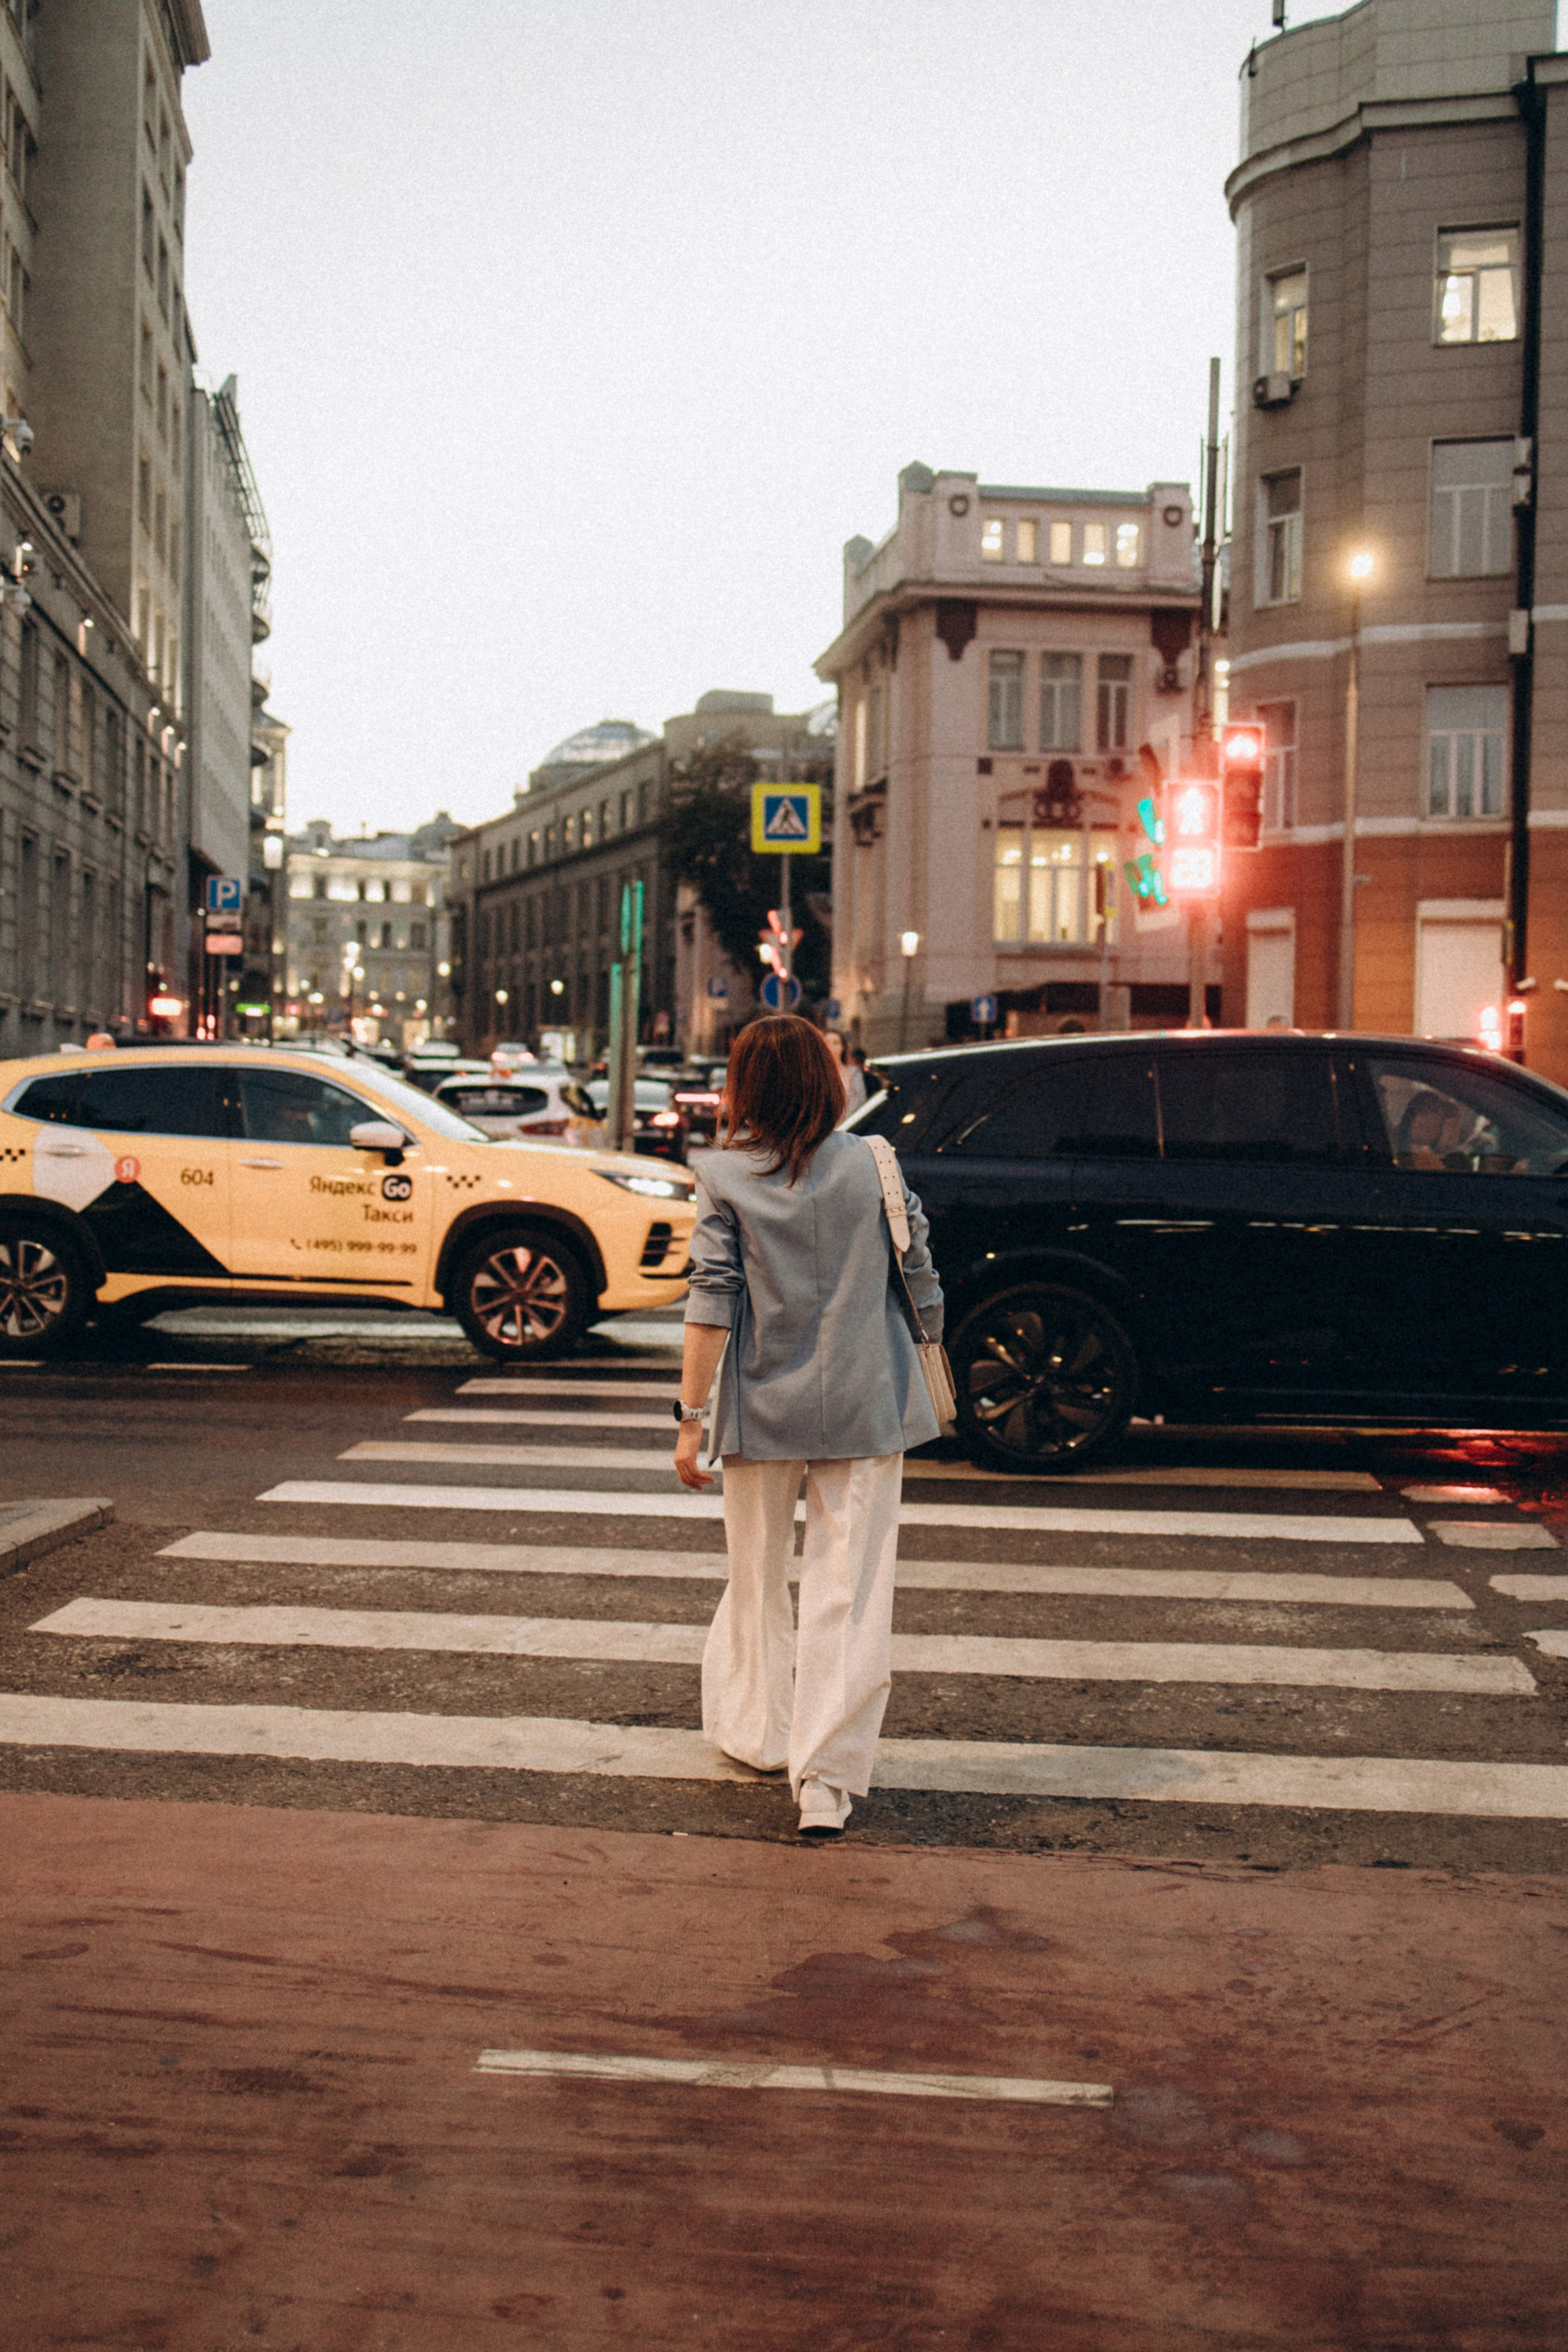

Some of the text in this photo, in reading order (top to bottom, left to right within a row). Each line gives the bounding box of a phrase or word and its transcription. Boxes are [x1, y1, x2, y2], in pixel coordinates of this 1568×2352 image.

[216, 880, 236, 908] P
[122, 1158, 135, 1177] Я
[181, 1168, 213, 1185] 604
[310, 1175, 412, 1197] Яндекс Go
[363, 1204, 413, 1223] Такси
